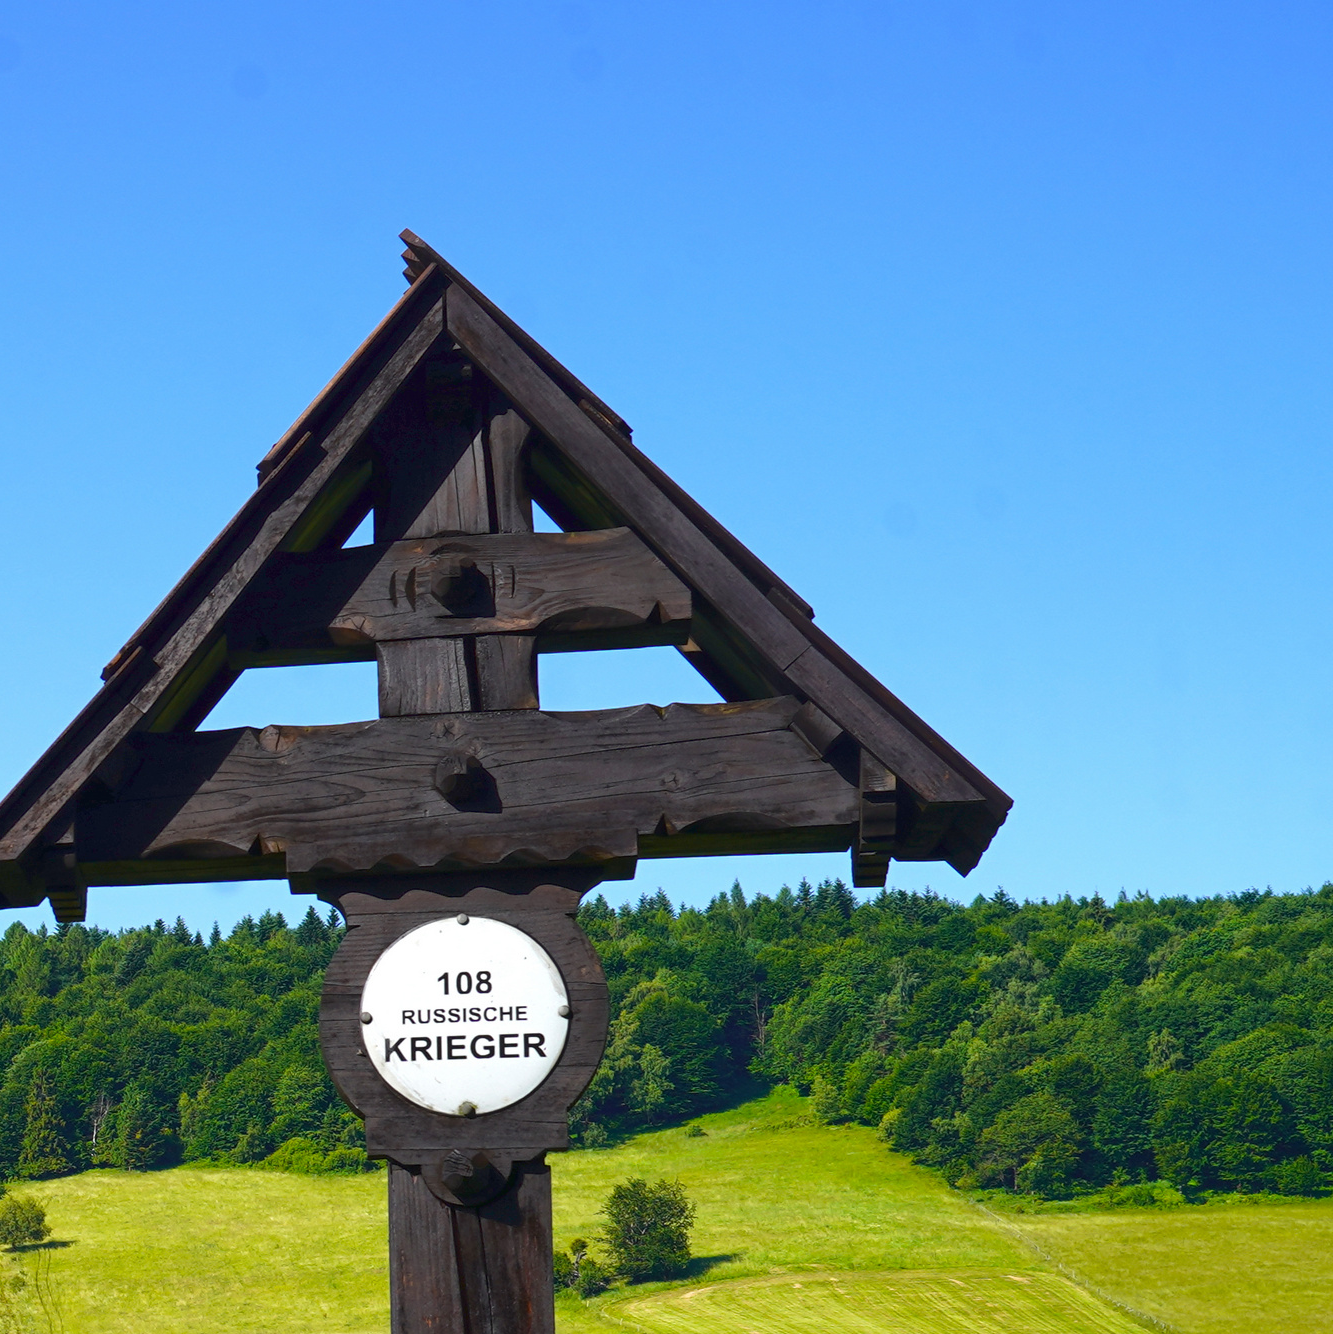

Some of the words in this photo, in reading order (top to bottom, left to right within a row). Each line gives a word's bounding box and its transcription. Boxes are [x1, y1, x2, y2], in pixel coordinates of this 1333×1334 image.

[438, 970, 492, 995] 108
[402, 1006, 528, 1024] RUSSISCHE
[385, 1032, 546, 1062] KRIEGER
